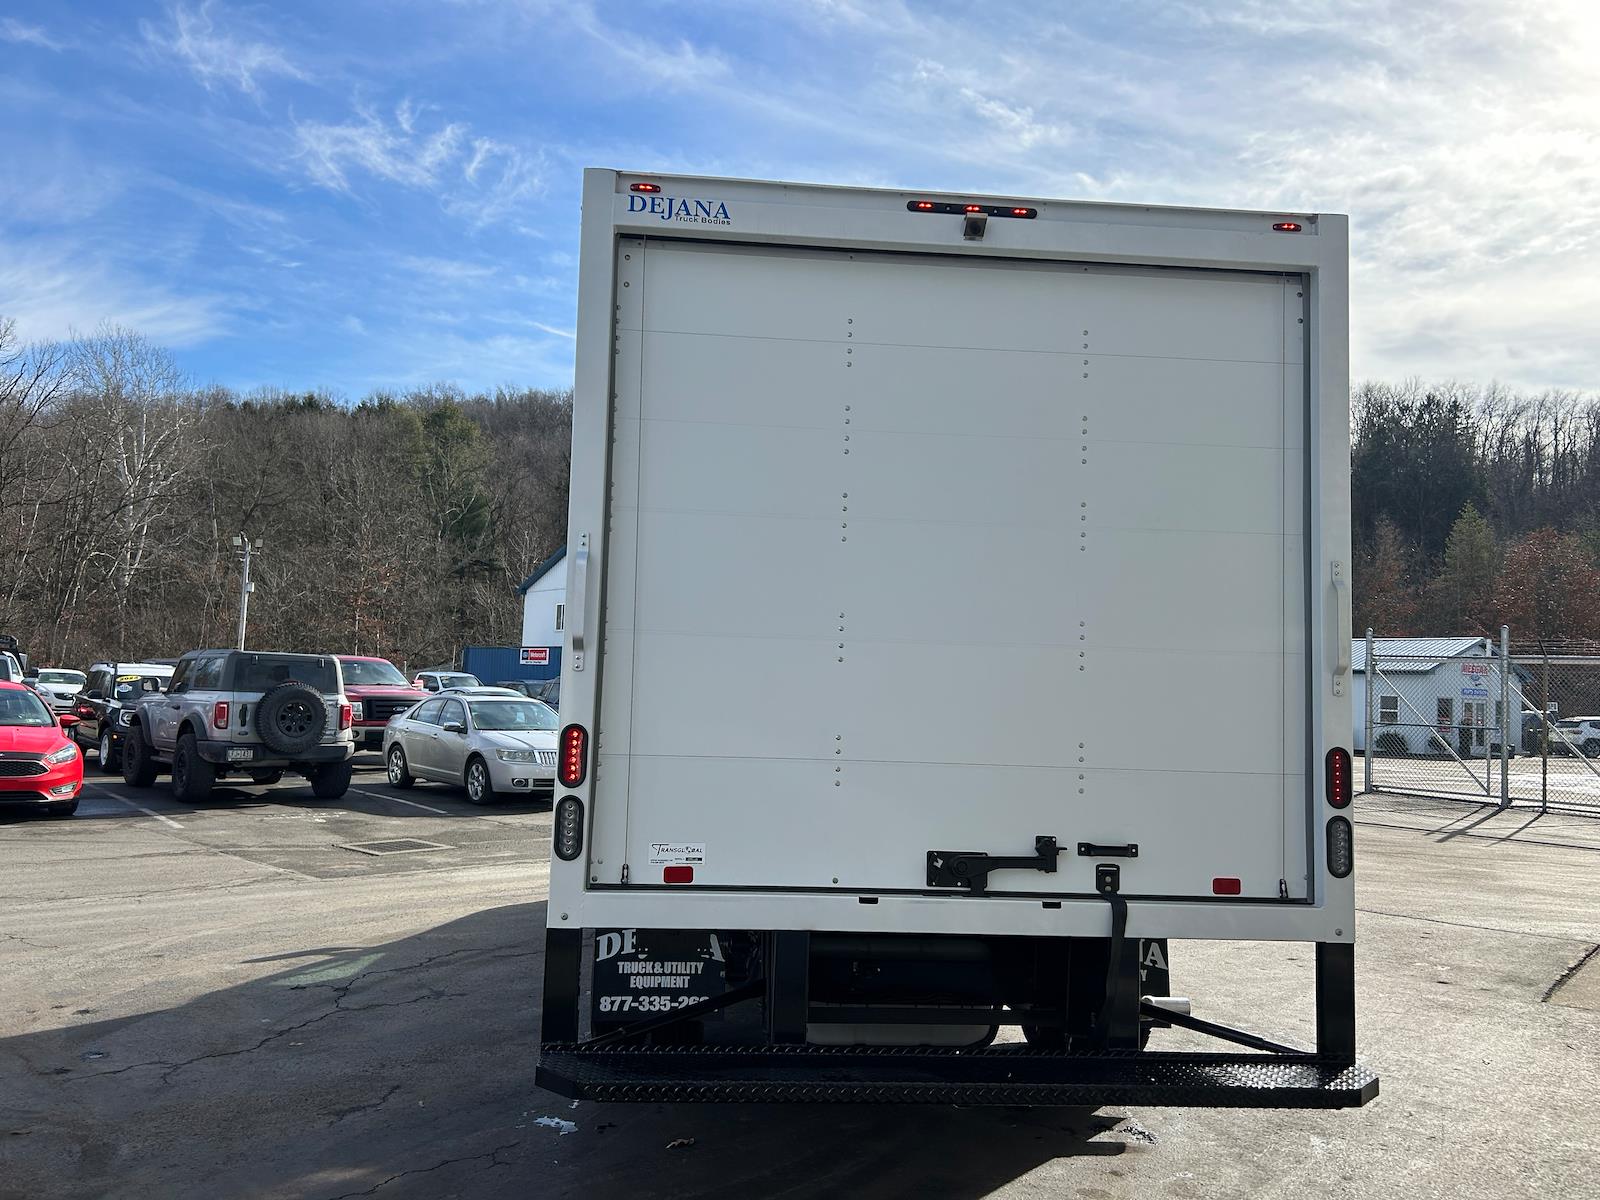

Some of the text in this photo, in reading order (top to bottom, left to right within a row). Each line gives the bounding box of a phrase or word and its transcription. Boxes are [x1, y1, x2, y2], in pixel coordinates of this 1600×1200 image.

[627, 194, 731, 221] DEJANA
[675, 214, 731, 226] Truck Bodies
[629, 975, 691, 990] EQUIPMENT
